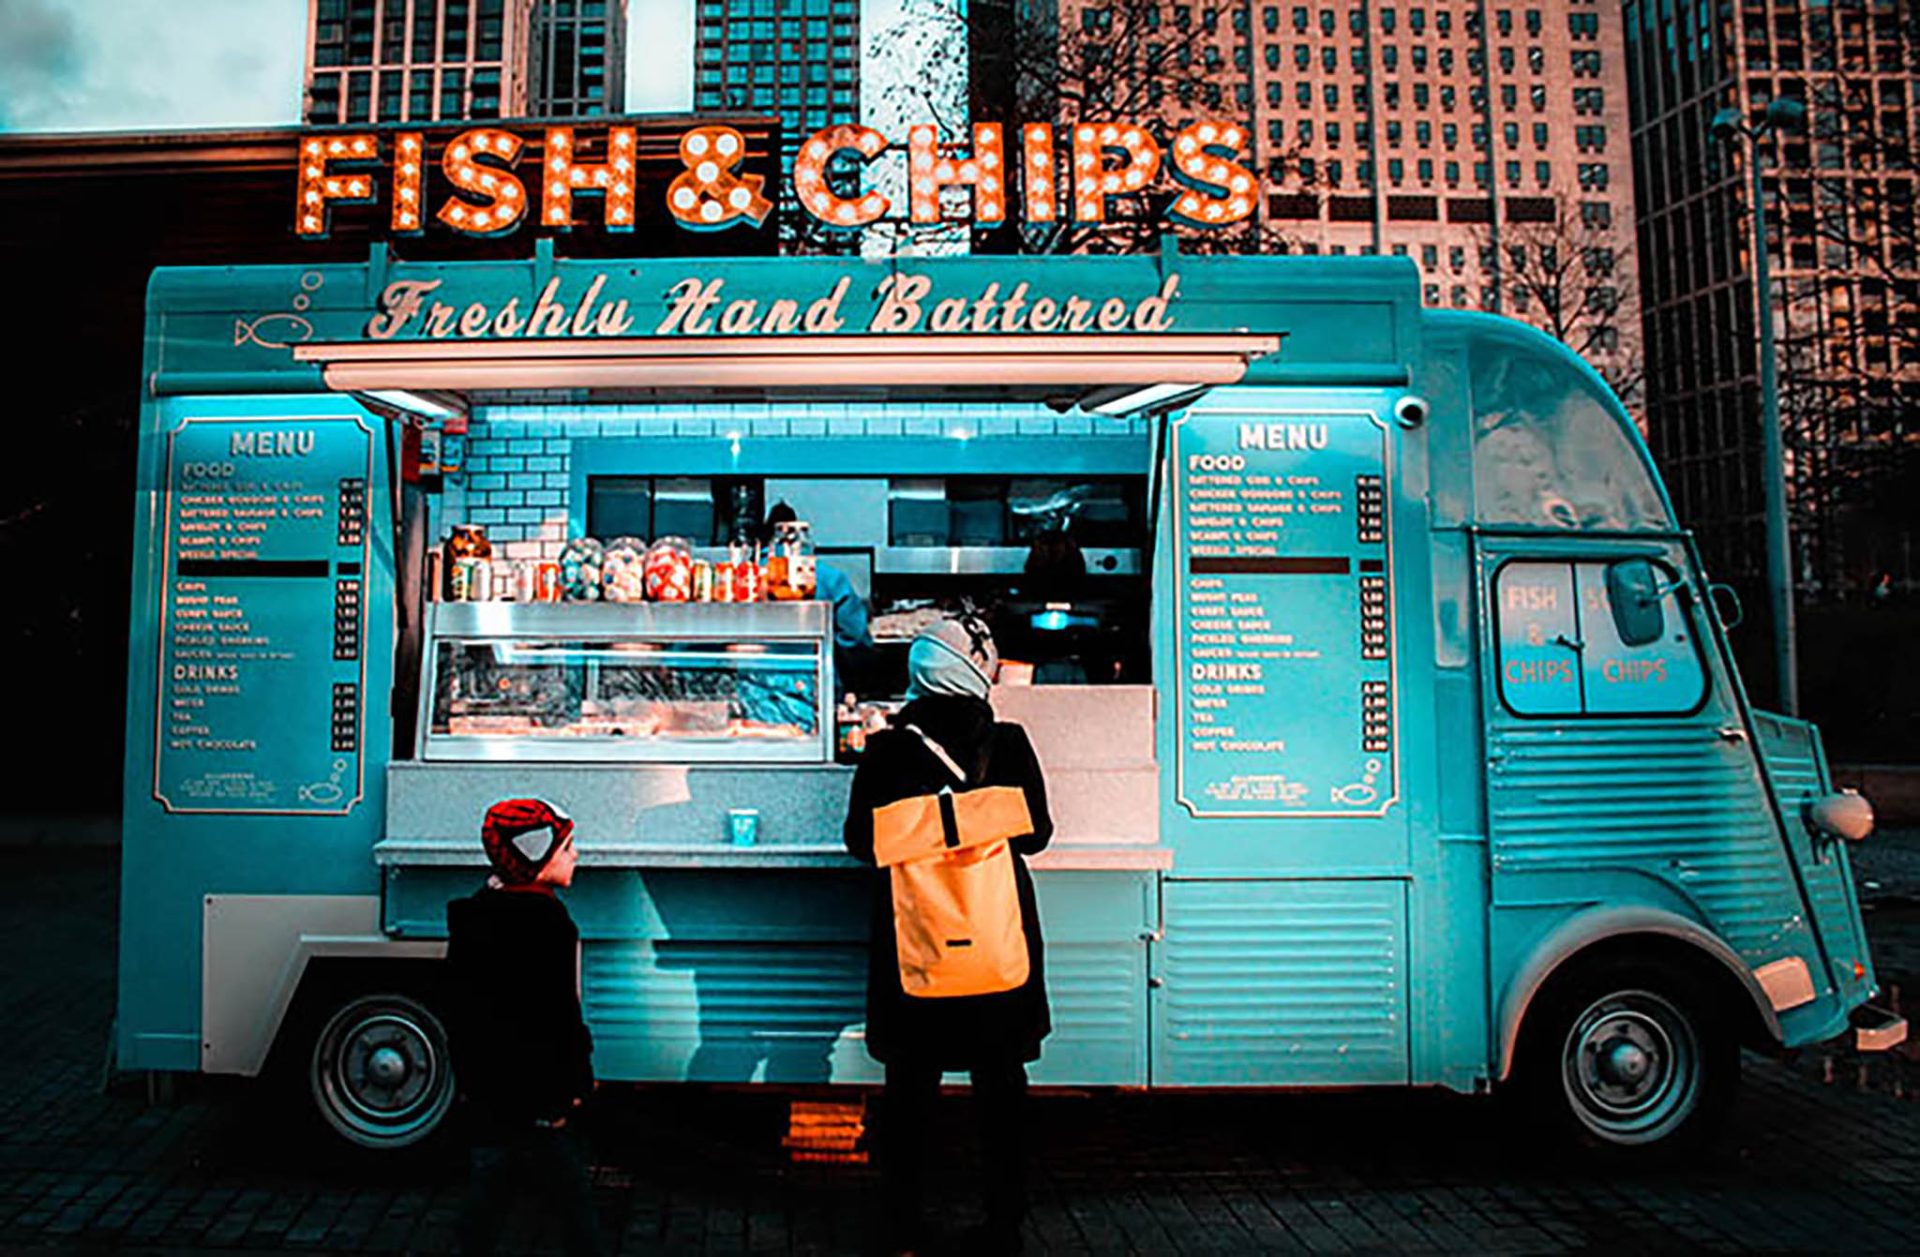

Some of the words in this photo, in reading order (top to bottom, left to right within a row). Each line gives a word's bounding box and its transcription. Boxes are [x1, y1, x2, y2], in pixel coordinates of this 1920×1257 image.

[295, 126, 638, 237] FISH
[666, 126, 774, 230] &
[794, 120, 1259, 228] CHIPS
[656, 276, 852, 336] Hand
[868, 272, 1180, 333] Battered
[231, 430, 314, 455] MENU
[1239, 423, 1328, 449] MENU
[184, 462, 235, 477] FOOD
[1189, 455, 1245, 470] FOOD
[1508, 586, 1557, 609] FISH
[174, 665, 238, 679] DRINKS
[1191, 664, 1262, 679] DRINKS
[1505, 660, 1573, 683] CHIPS
[1602, 659, 1667, 683] CHIPS
